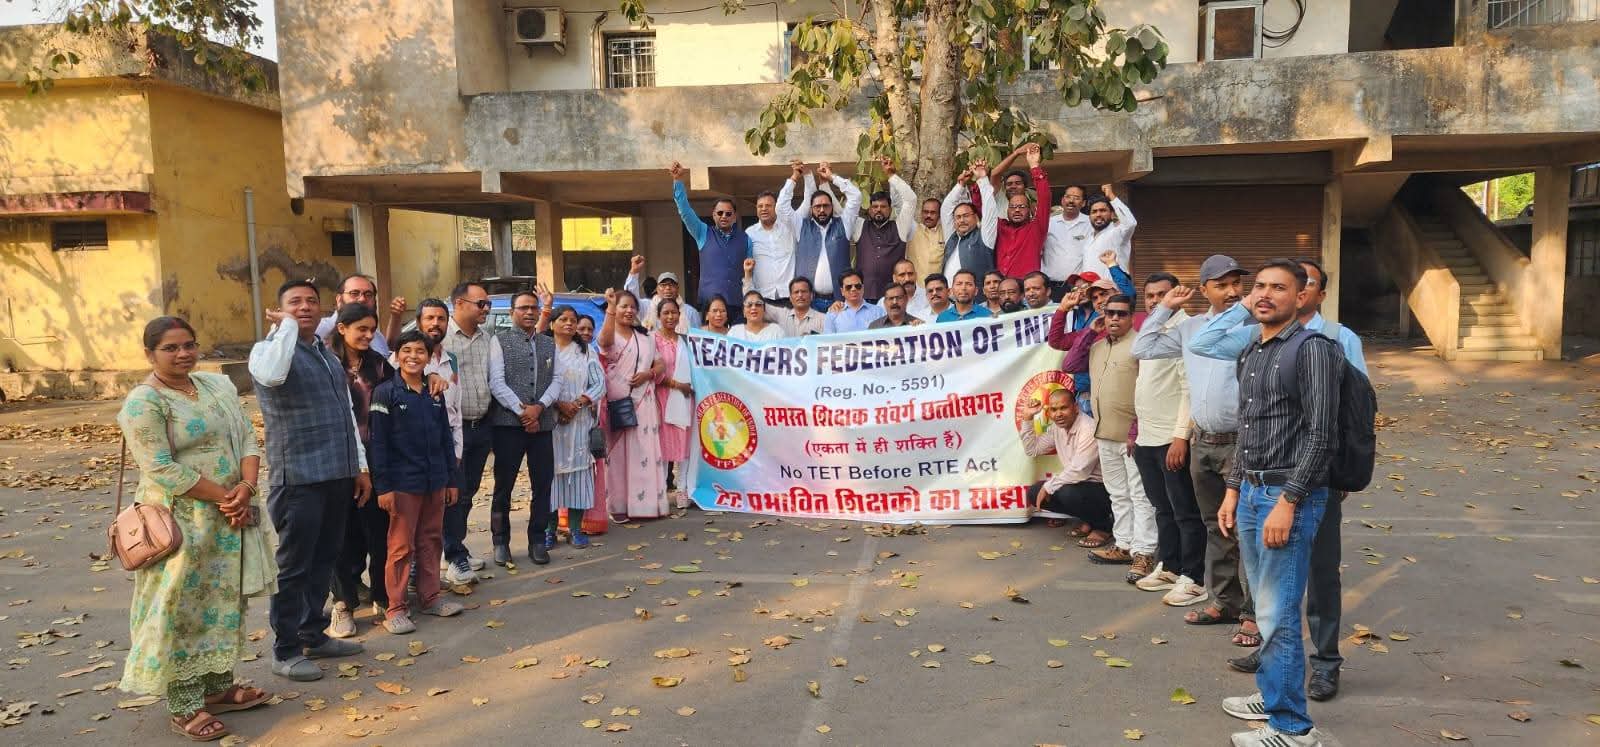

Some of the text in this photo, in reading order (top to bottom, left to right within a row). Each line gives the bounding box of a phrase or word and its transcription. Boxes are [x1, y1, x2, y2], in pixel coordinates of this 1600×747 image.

[688, 313, 1056, 376] TEACHERS FEDERATION OF IND
[815, 374, 945, 400] (Reg. No.- 5591)
[763, 392, 1004, 428] समस्त शिक्षक संवर्ग छत्तीसगढ़
[805, 439, 849, 457] (एकता
[855, 437, 867, 453] में
[873, 437, 888, 454] ही
[895, 434, 937, 453] शक्ति
[780, 457, 998, 480] No TET Before RTE Act
[929, 487, 960, 512] का
